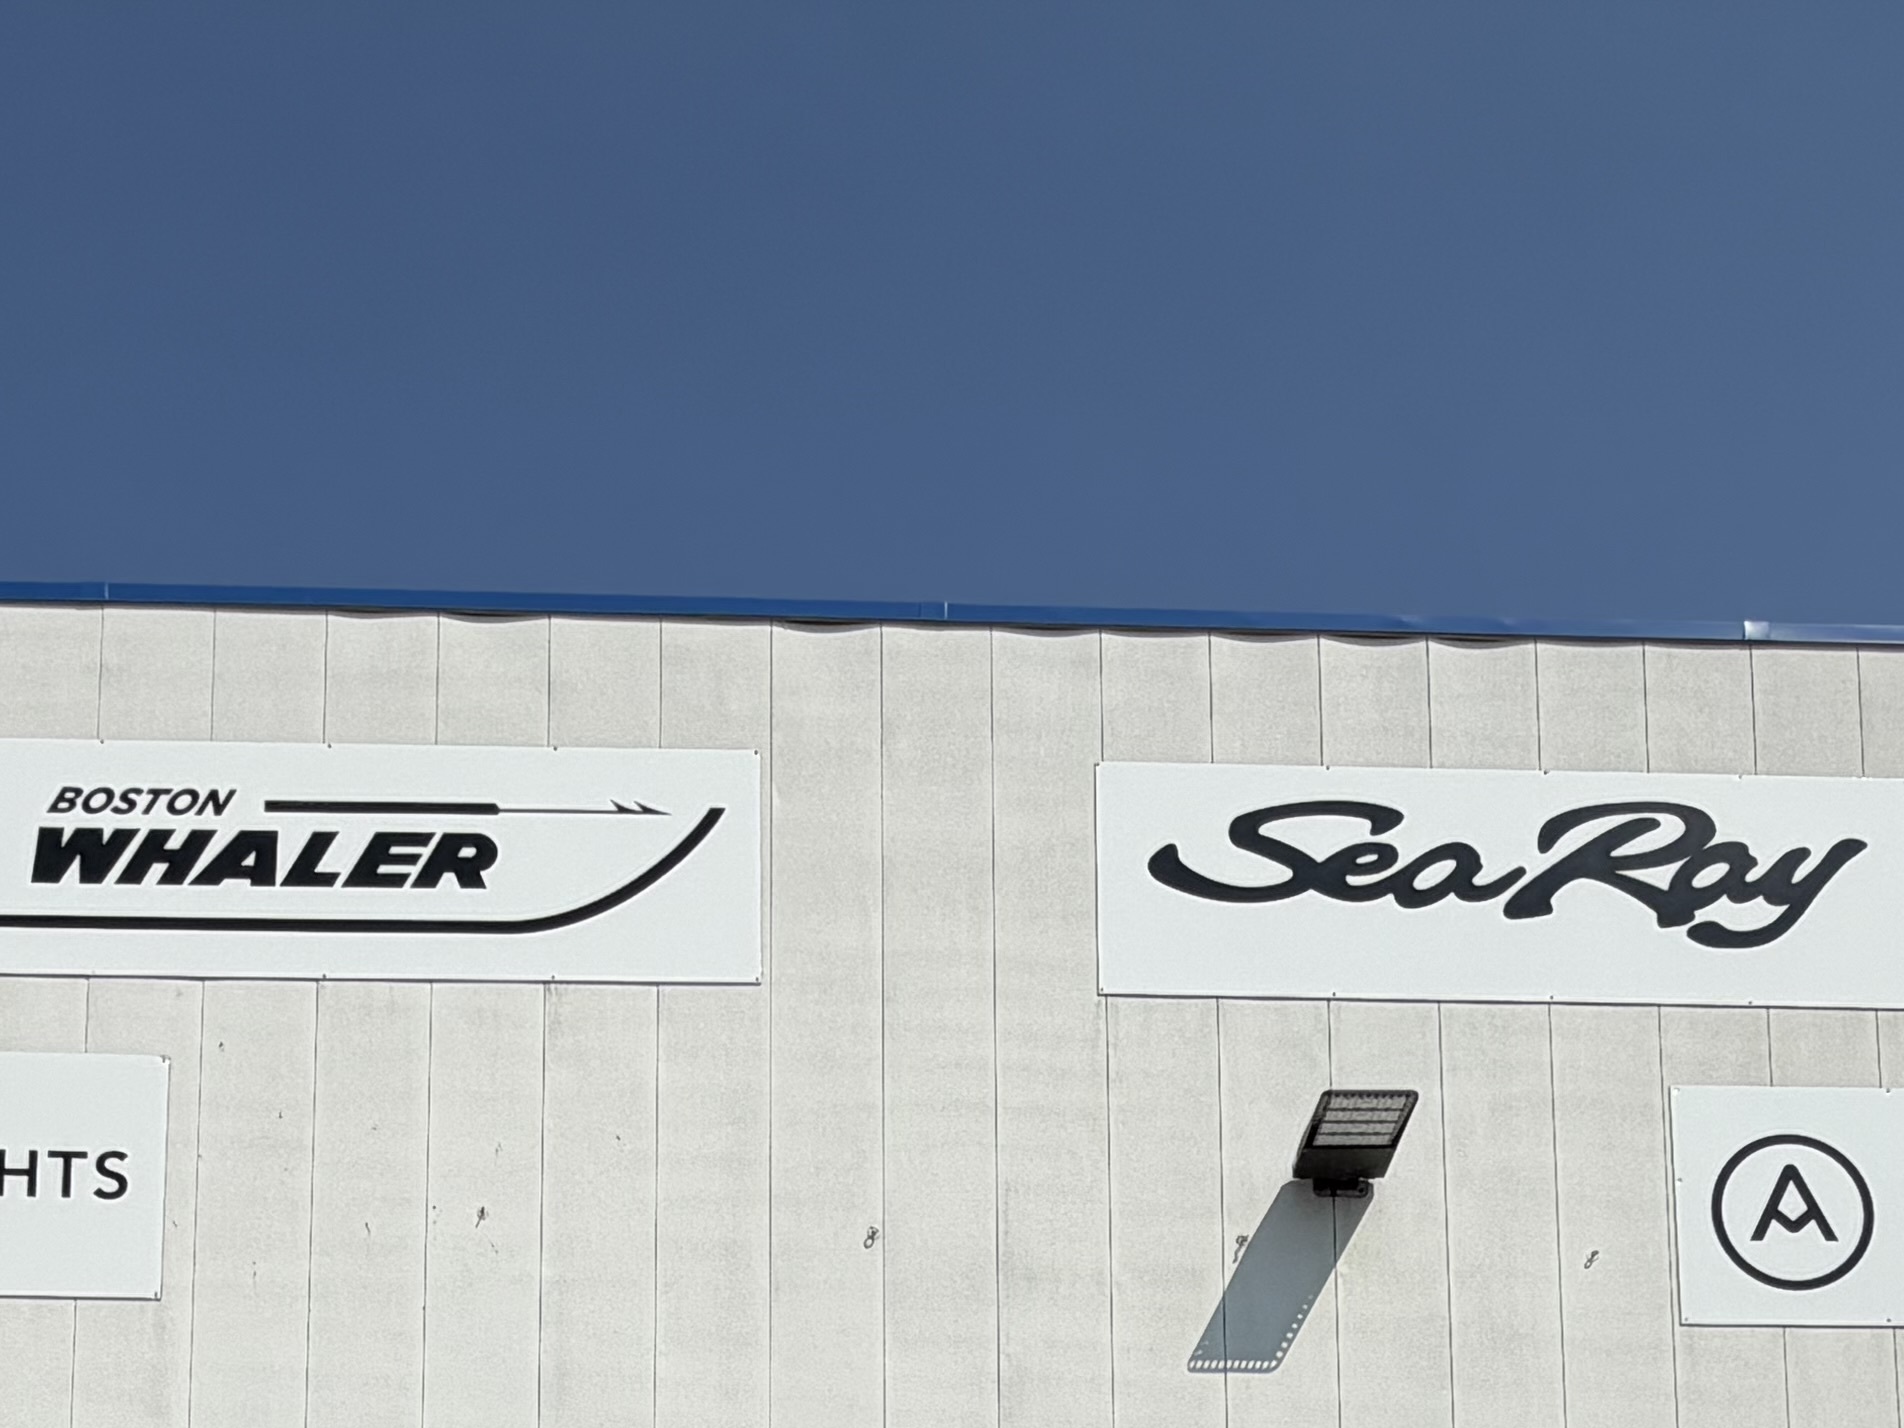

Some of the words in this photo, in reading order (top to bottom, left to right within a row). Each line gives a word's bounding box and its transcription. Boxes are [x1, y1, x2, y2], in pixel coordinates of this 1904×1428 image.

[47, 786, 236, 816] BOSTON
[30, 826, 499, 890] WHALER
[1147, 800, 1527, 909] Sea
[1502, 801, 1868, 949] Ray
